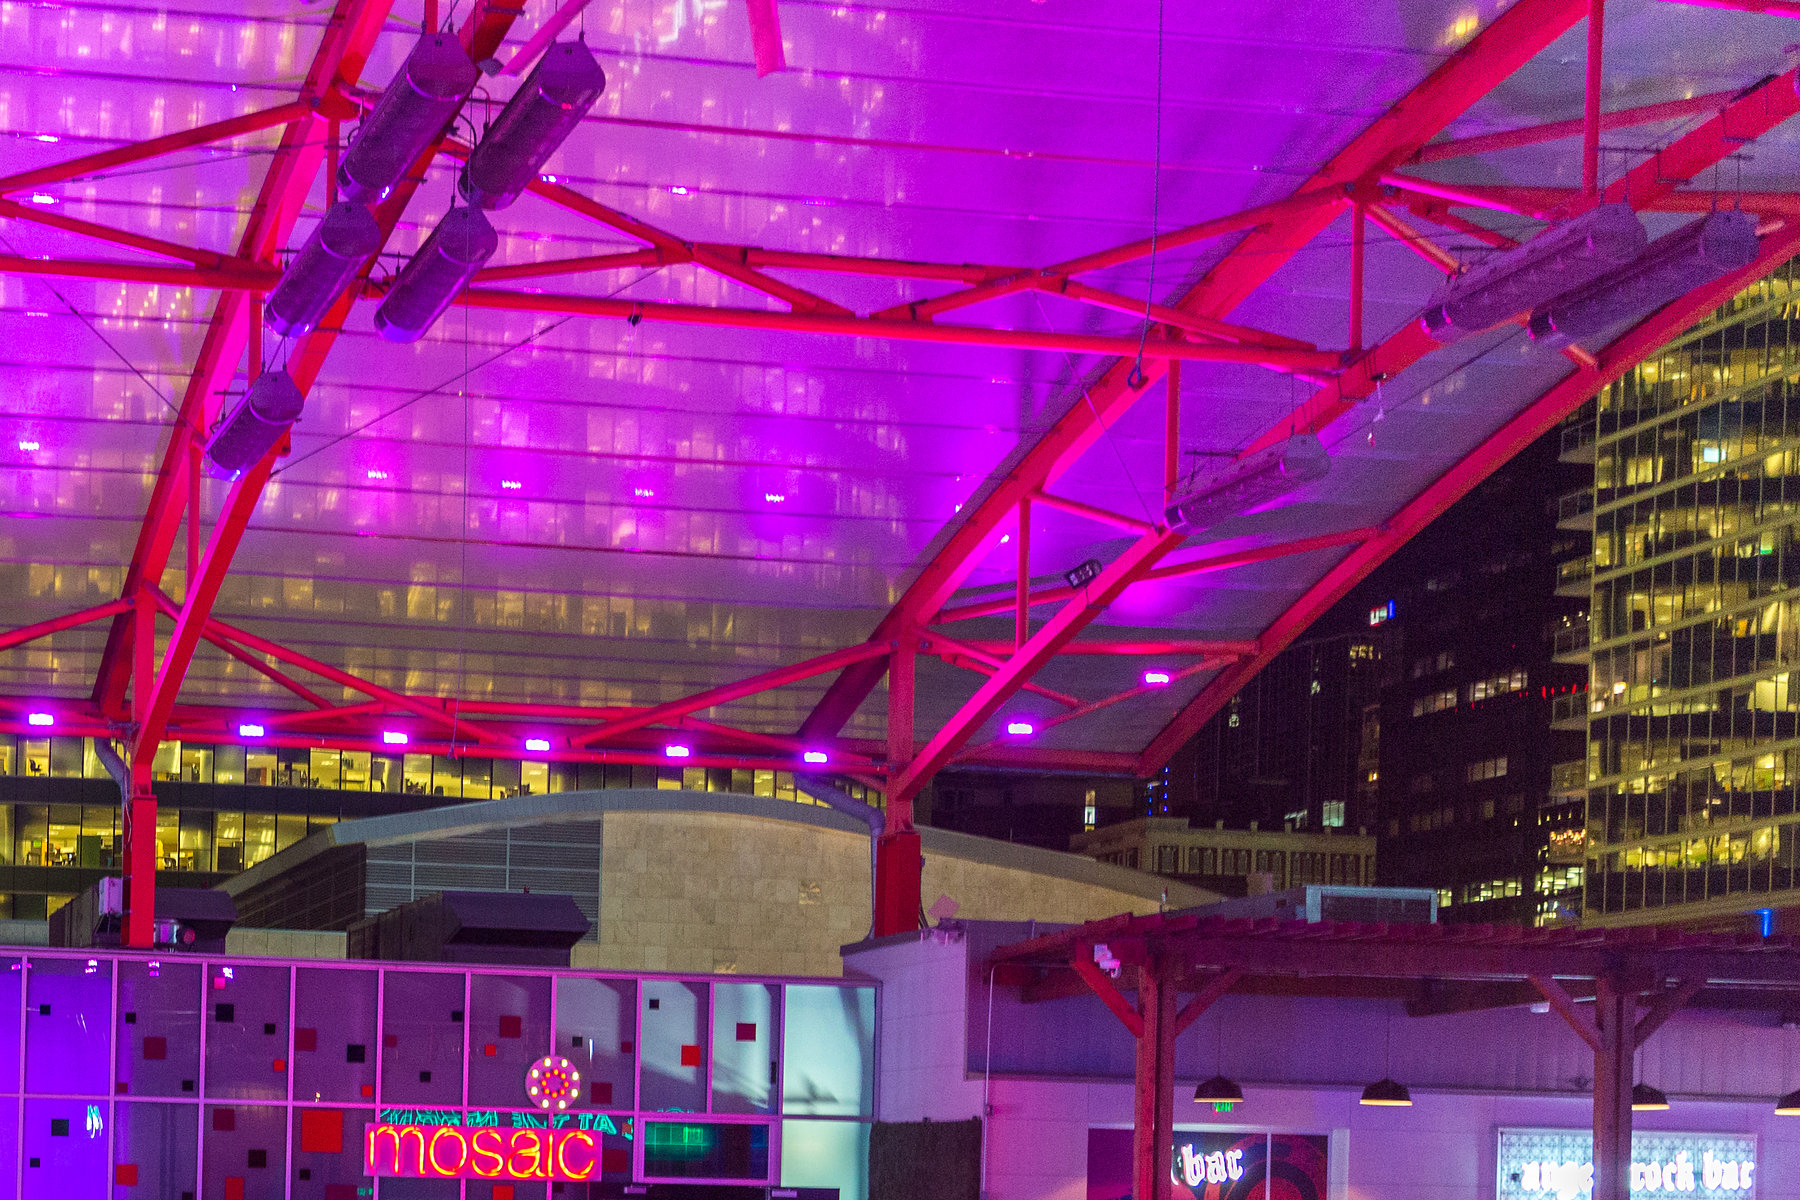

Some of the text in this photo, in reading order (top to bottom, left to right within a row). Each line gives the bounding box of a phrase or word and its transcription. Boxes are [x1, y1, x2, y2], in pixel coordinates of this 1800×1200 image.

[368, 1125, 595, 1180] mosaic
[1181, 1144, 1245, 1187] bar
[1630, 1150, 1695, 1192] rock
[1702, 1150, 1756, 1191] bar
